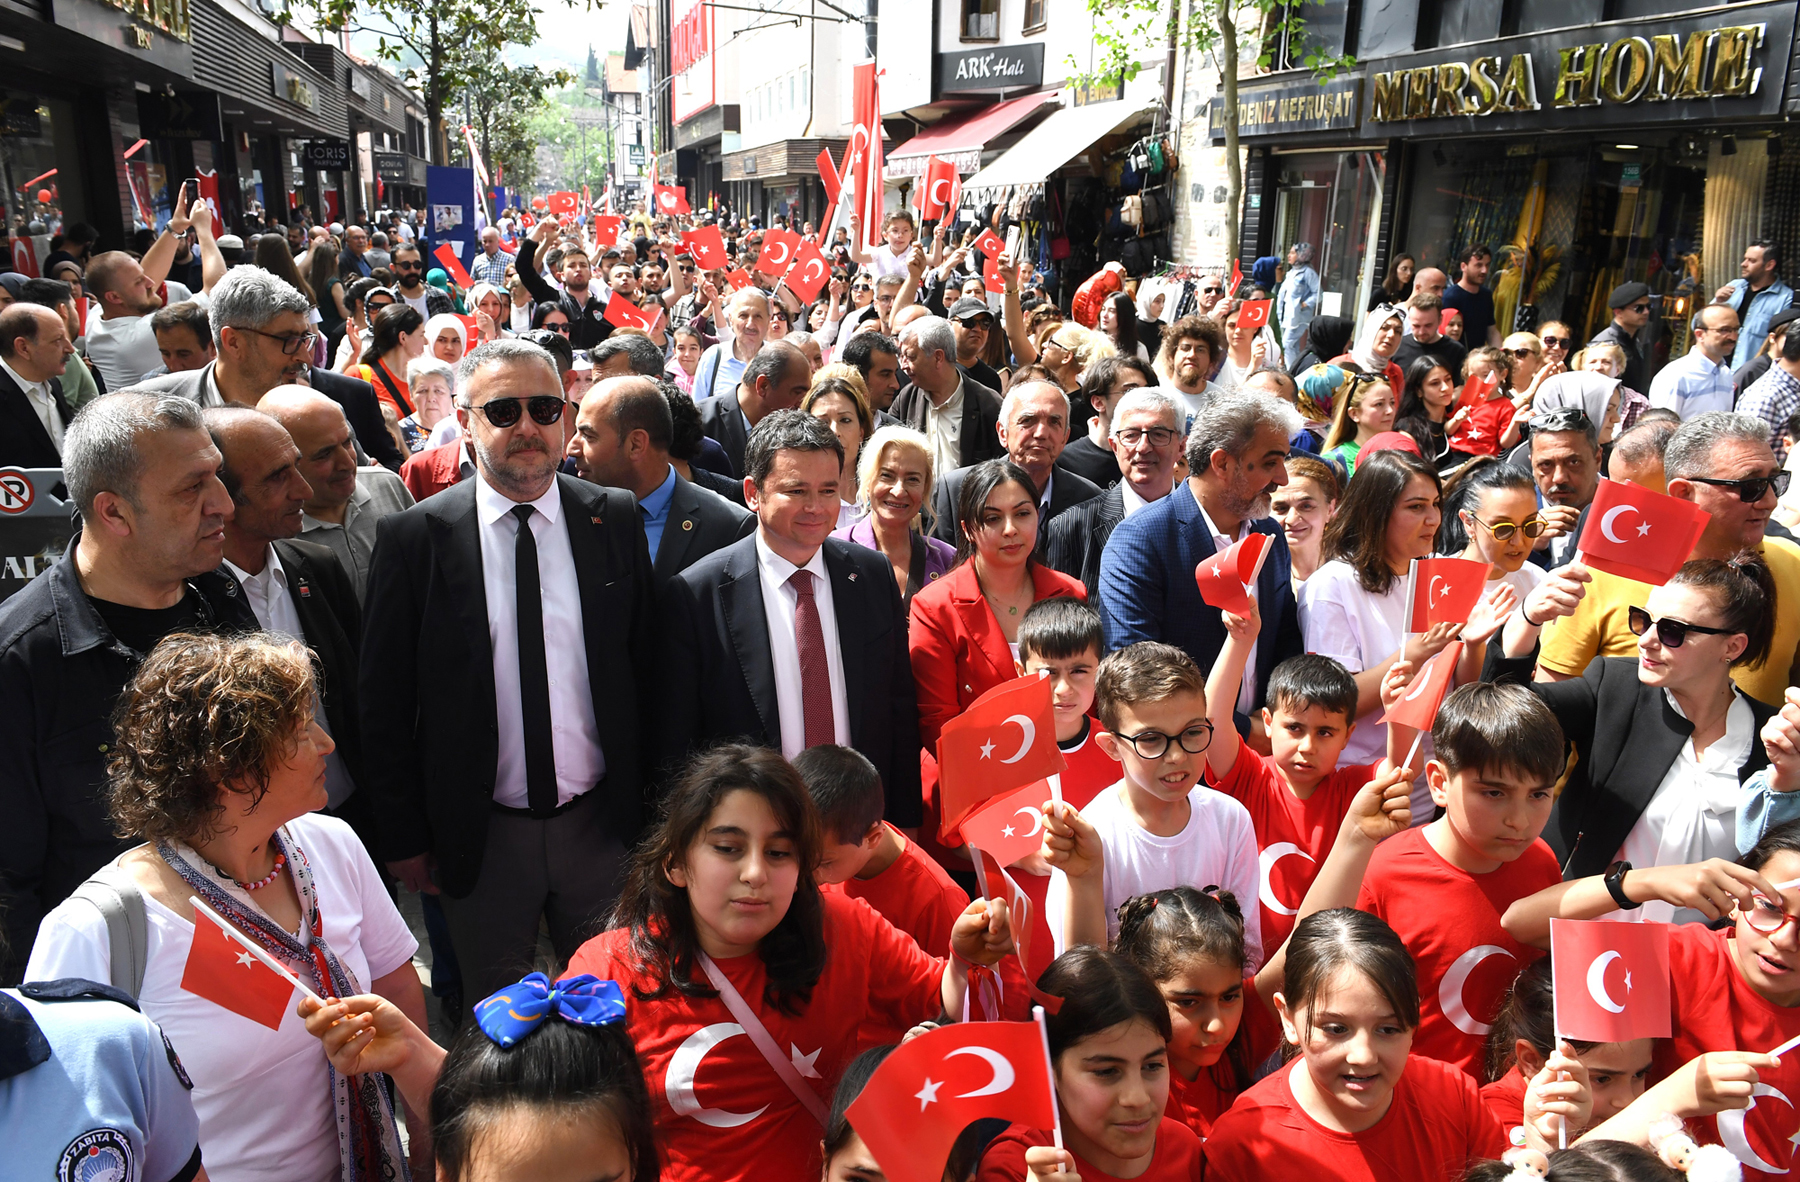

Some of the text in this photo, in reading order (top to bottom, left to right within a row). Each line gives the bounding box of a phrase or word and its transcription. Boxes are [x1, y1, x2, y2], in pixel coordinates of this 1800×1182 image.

[955, 55, 1024, 80] ARK Halı
[1368, 22, 1767, 122] MERSA HOME
[1278, 91, 1354, 124] MEFRUŞAT
[307, 147, 347, 159] LORIS
[70, 1132, 110, 1157] ZABITA
